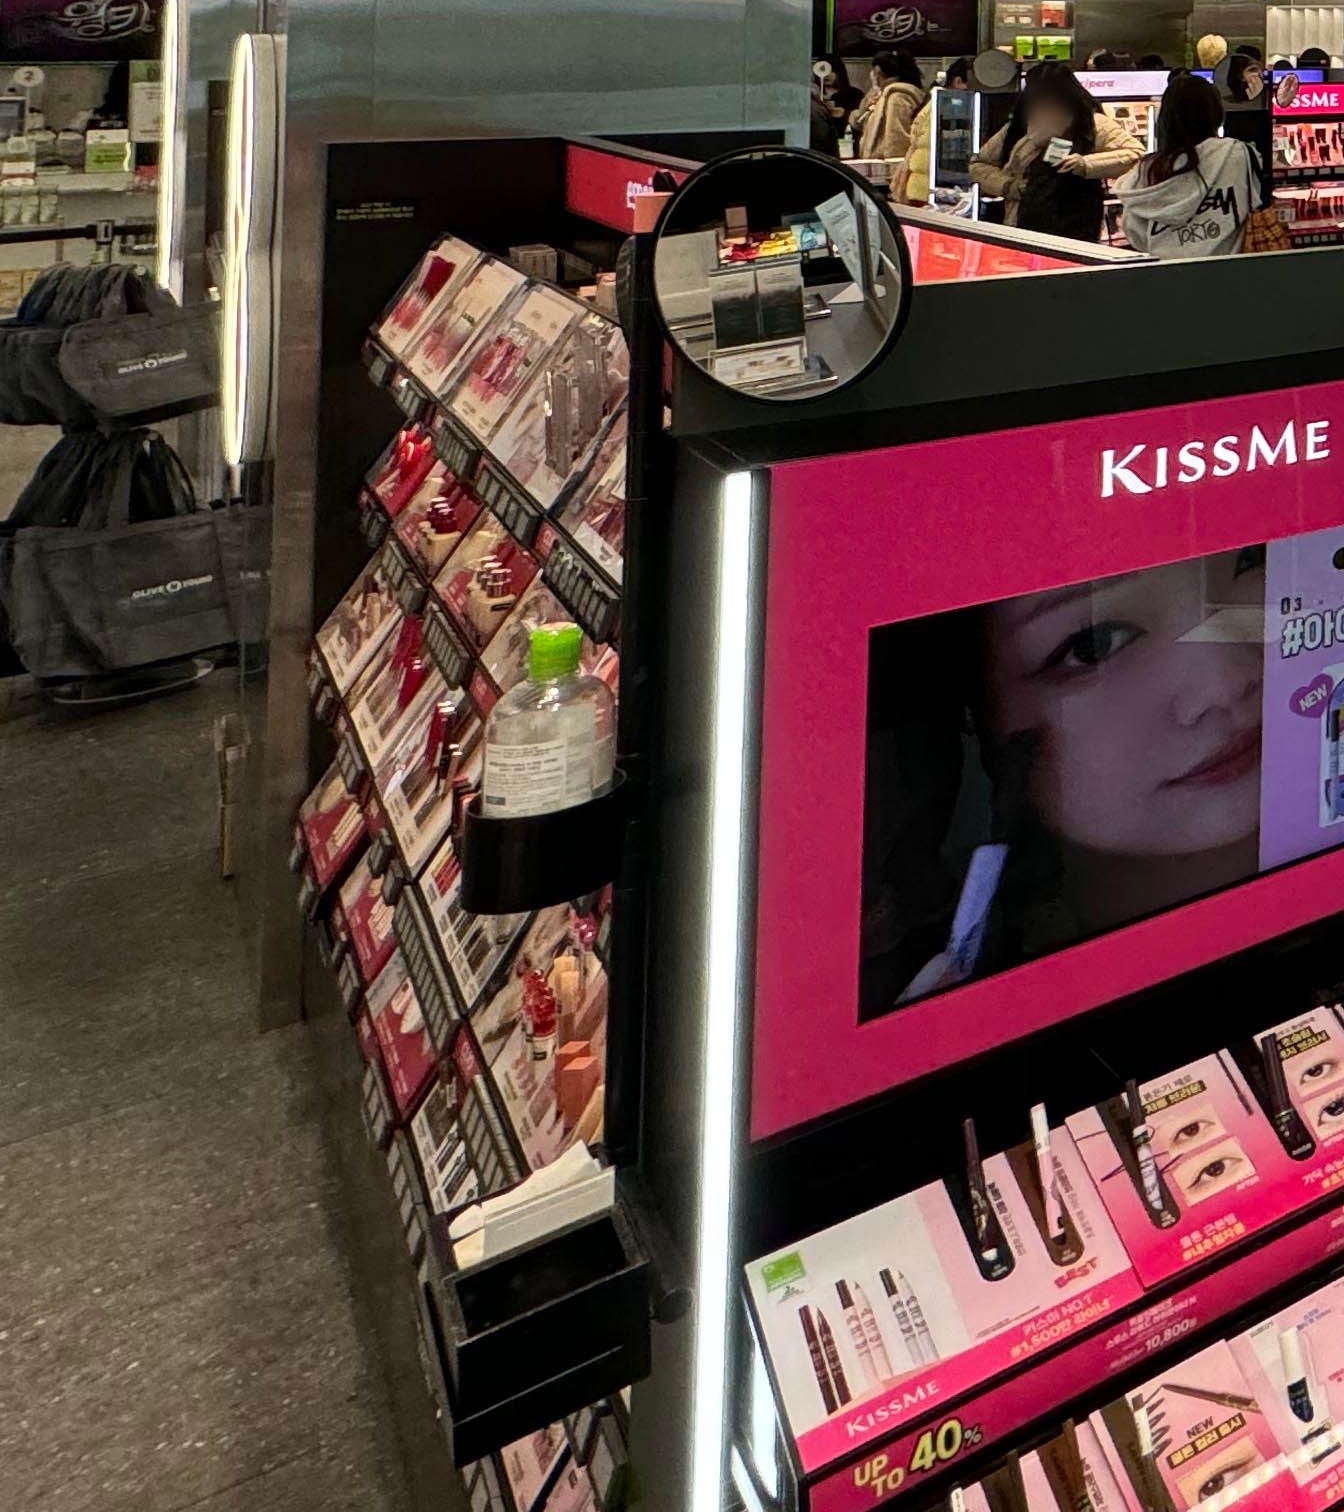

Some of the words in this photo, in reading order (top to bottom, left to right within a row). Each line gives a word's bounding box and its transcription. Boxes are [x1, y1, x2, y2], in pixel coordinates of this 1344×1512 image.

[1099, 420, 1331, 497] KISSME
[1299, 684, 1328, 713] NEW
[1010, 1321, 1073, 1359] #1,500만
[1023, 1308, 1060, 1338] 키스미
[846, 1379, 940, 1437] KISSME
[1186, 1416, 1214, 1438] NEW
[909, 1419, 982, 1473] 40%
[853, 1452, 889, 1487] UP
[871, 1466, 905, 1497] TO
